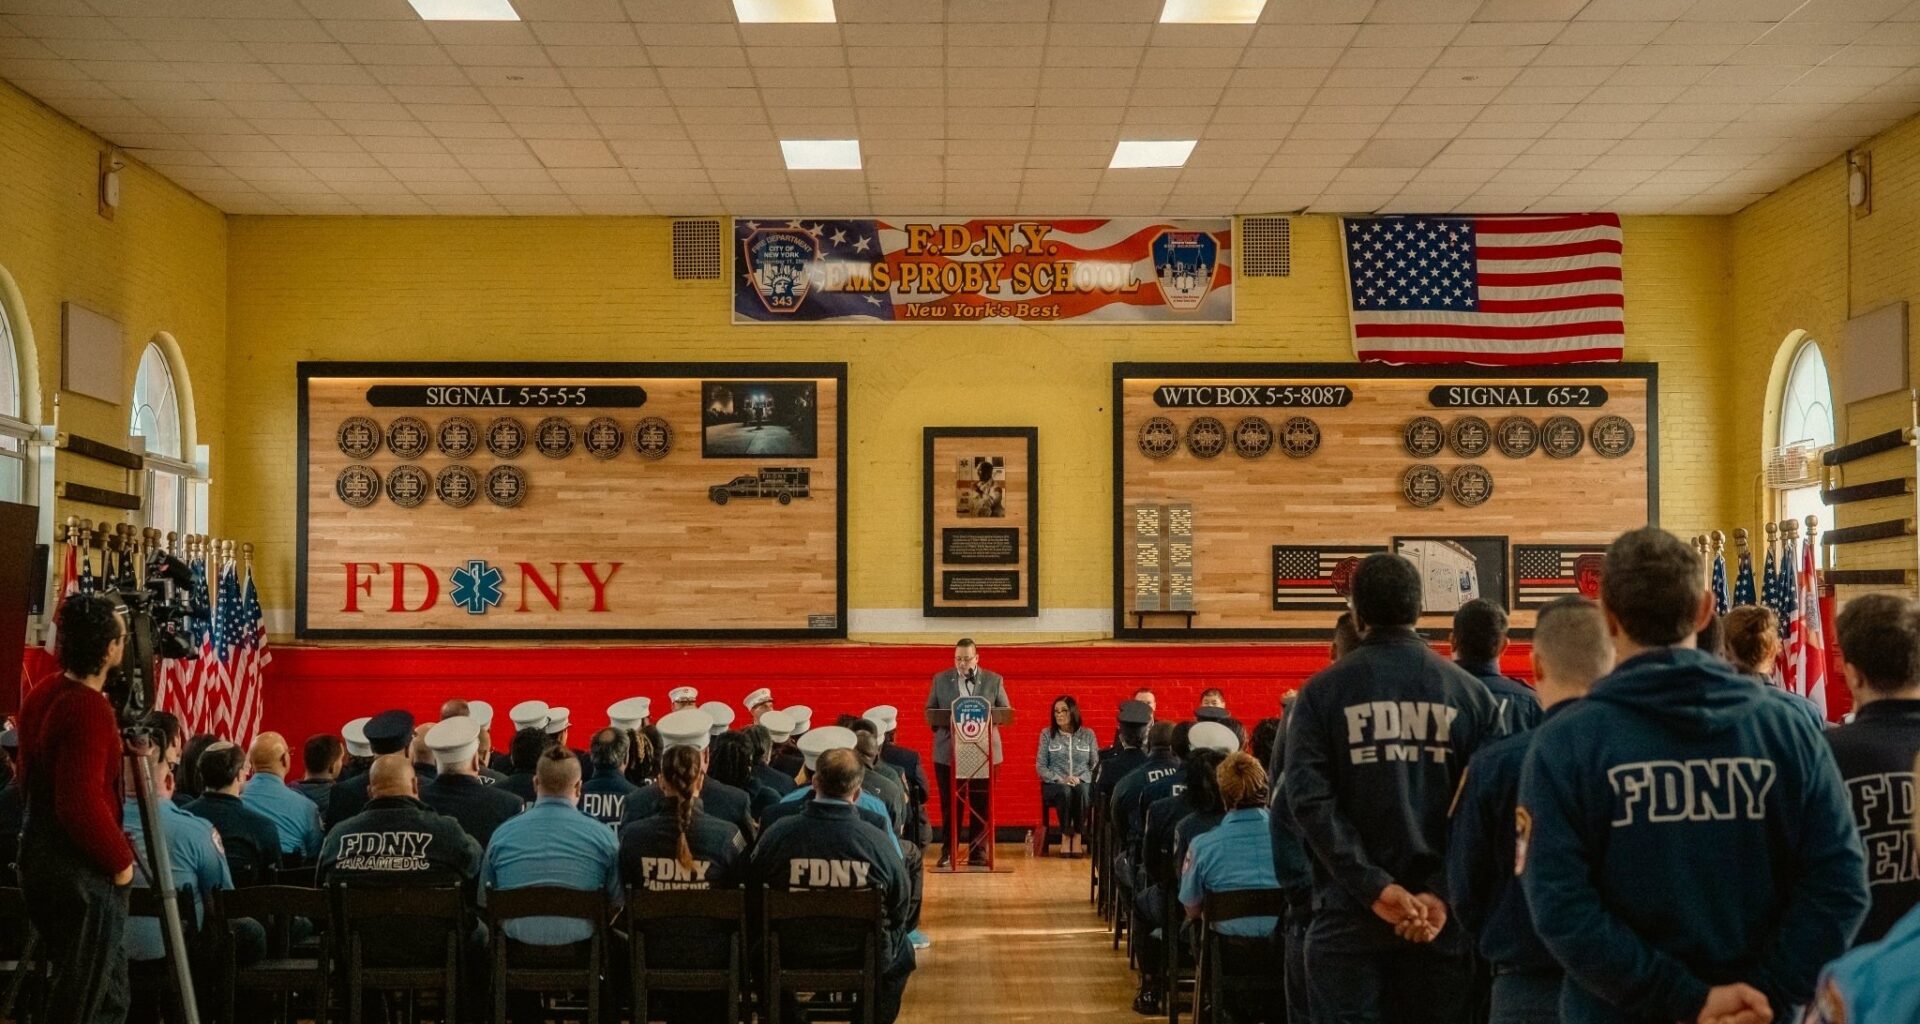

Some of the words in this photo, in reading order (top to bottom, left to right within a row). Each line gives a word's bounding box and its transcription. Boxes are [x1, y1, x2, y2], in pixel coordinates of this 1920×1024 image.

[766, 234, 812, 253] DEPARTMENT
[905, 224, 1058, 255] F.D.N.Y.
[824, 262, 891, 293] EMS
[898, 262, 1002, 293] PROBY
[1013, 262, 1141, 293] SCHOOL
[772, 296, 793, 306] 343
[905, 303, 947, 317] New
[952, 303, 1012, 317] York's
[1014, 303, 1060, 317] Best
[426, 387, 511, 405] SIGNAL
[519, 387, 586, 405] 5-5-5-5
[1161, 387, 1212, 405] WTC
[1216, 387, 1261, 405] BOX
[1266, 387, 1345, 405] 5-5-8087
[1450, 387, 1539, 405] SIGNAL
[1547, 387, 1590, 405] 65-2
[1343, 701, 1458, 744] FDNY
[1350, 744, 1453, 765] EMT
[1607, 757, 1777, 827] FDNY
[583, 793, 625, 817] FDNY
[337, 832, 433, 859] FDNY
[335, 855, 430, 871] PARAMEDIC
[641, 857, 712, 882] FDNY
[789, 858, 871, 887] FDNY
